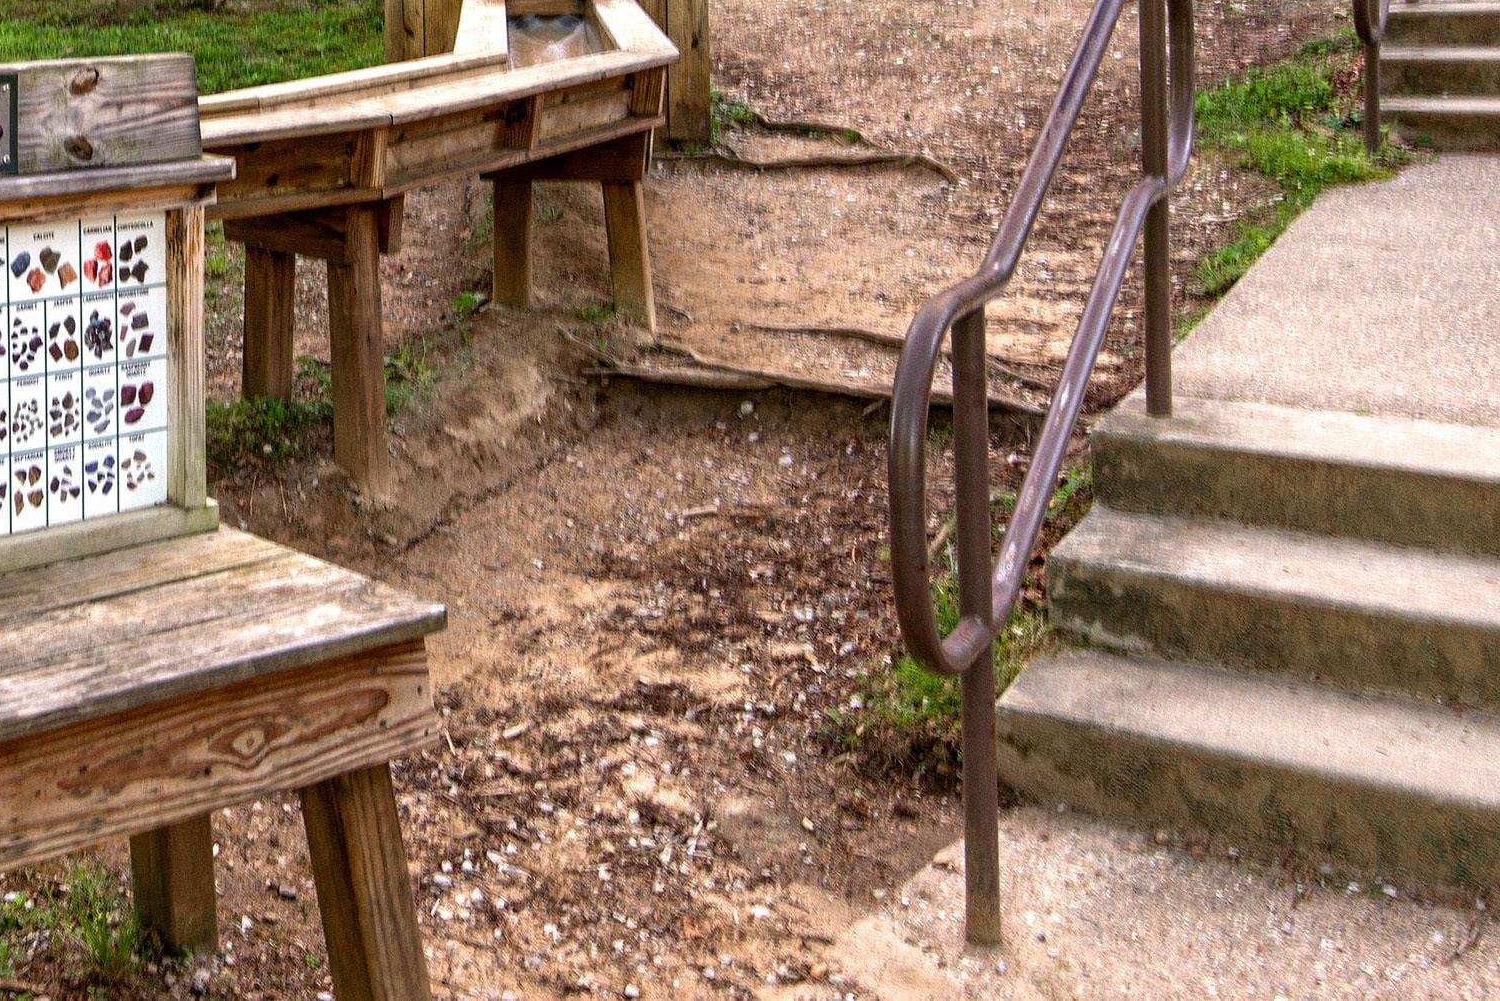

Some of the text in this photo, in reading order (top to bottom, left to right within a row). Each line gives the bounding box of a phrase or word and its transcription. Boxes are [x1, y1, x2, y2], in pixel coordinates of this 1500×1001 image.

[84, 226, 112, 235] CARNELIAN
[33, 232, 54, 240] CALCITE
[53, 299, 73, 307] JASPER
[89, 367, 110, 376] QUARTZ
[55, 374, 73, 382] PYRITE
[129, 435, 145, 443] TOPAZ
[88, 440, 112, 449] SODALITE
[55, 454, 75, 463] QUARTZ
